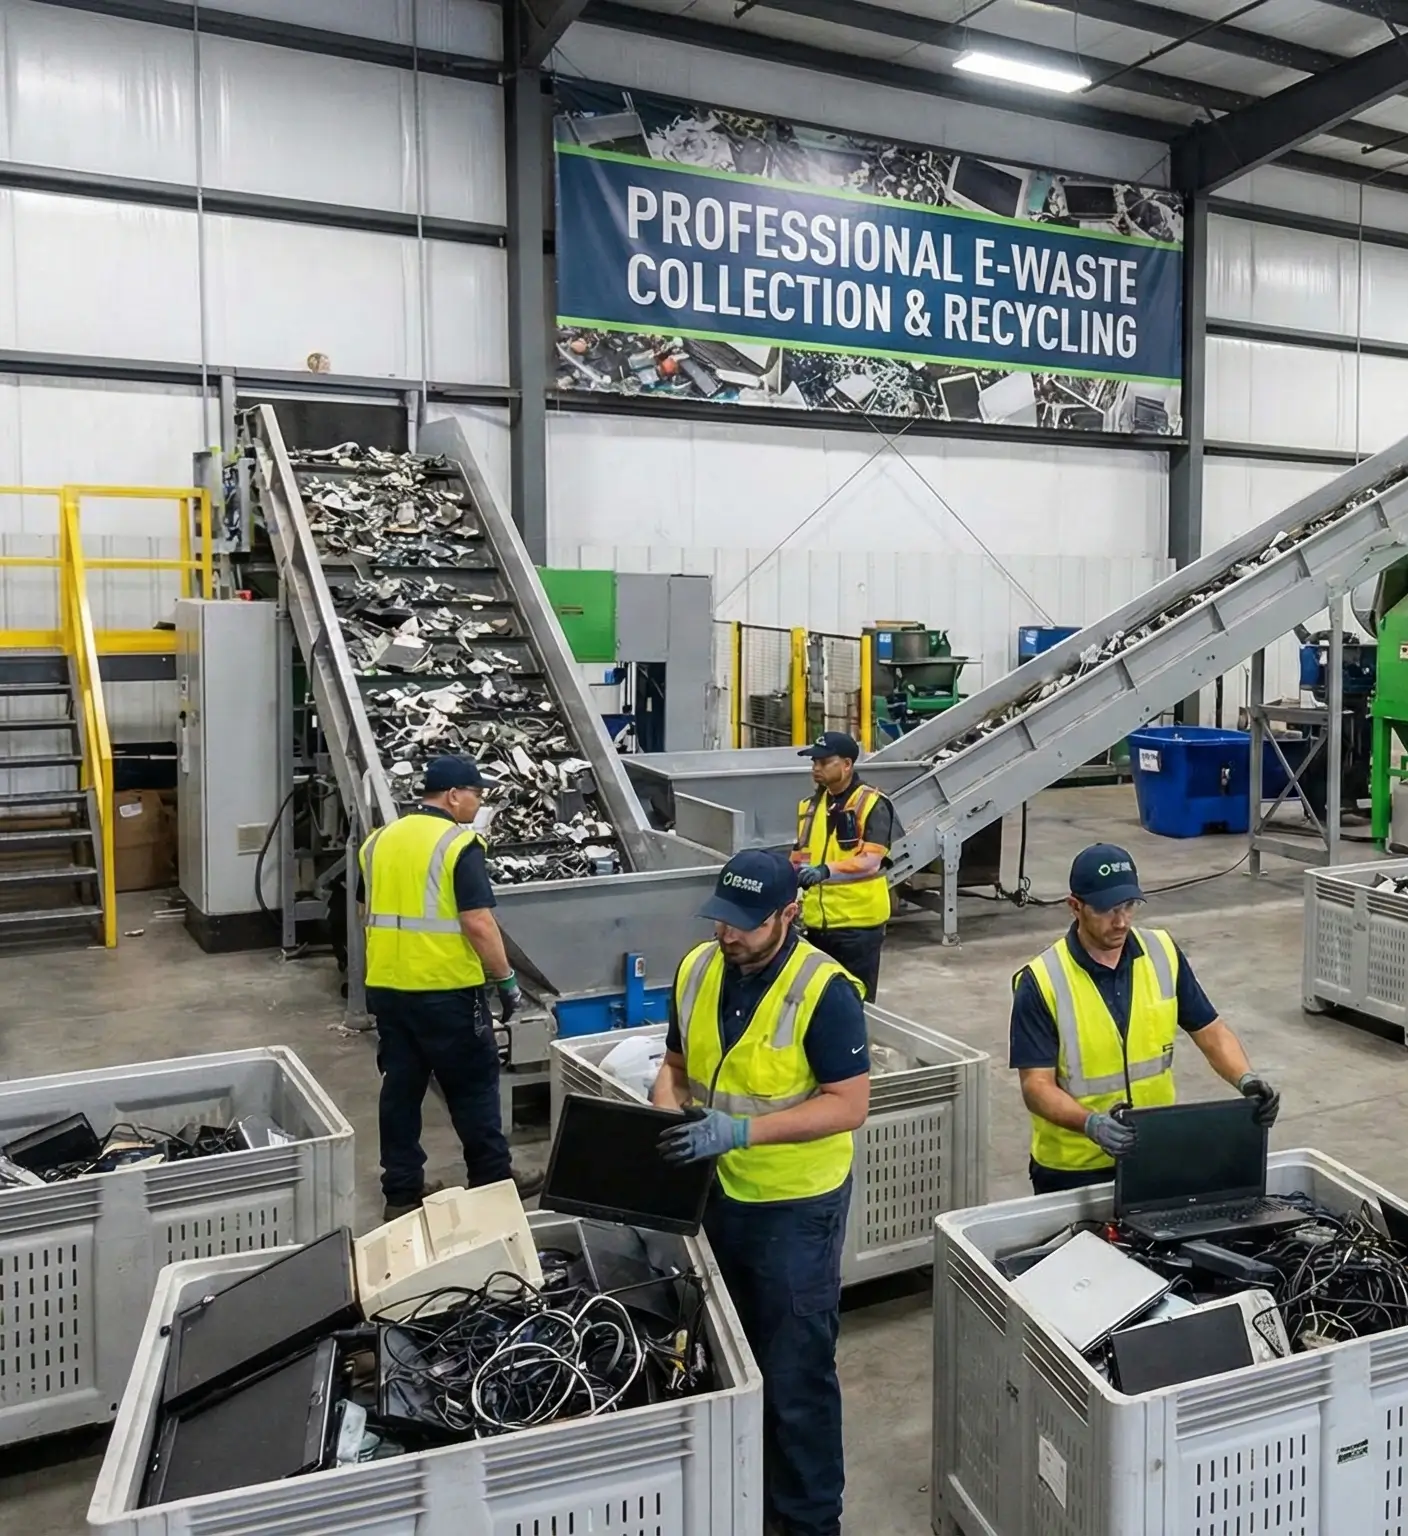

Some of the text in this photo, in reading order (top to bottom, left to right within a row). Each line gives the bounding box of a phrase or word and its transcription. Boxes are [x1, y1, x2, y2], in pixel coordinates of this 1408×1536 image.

[627, 186, 1138, 306] PROFESSIONAL E-WASTE
[627, 253, 1138, 359] COLLECTION & RECYCLING
